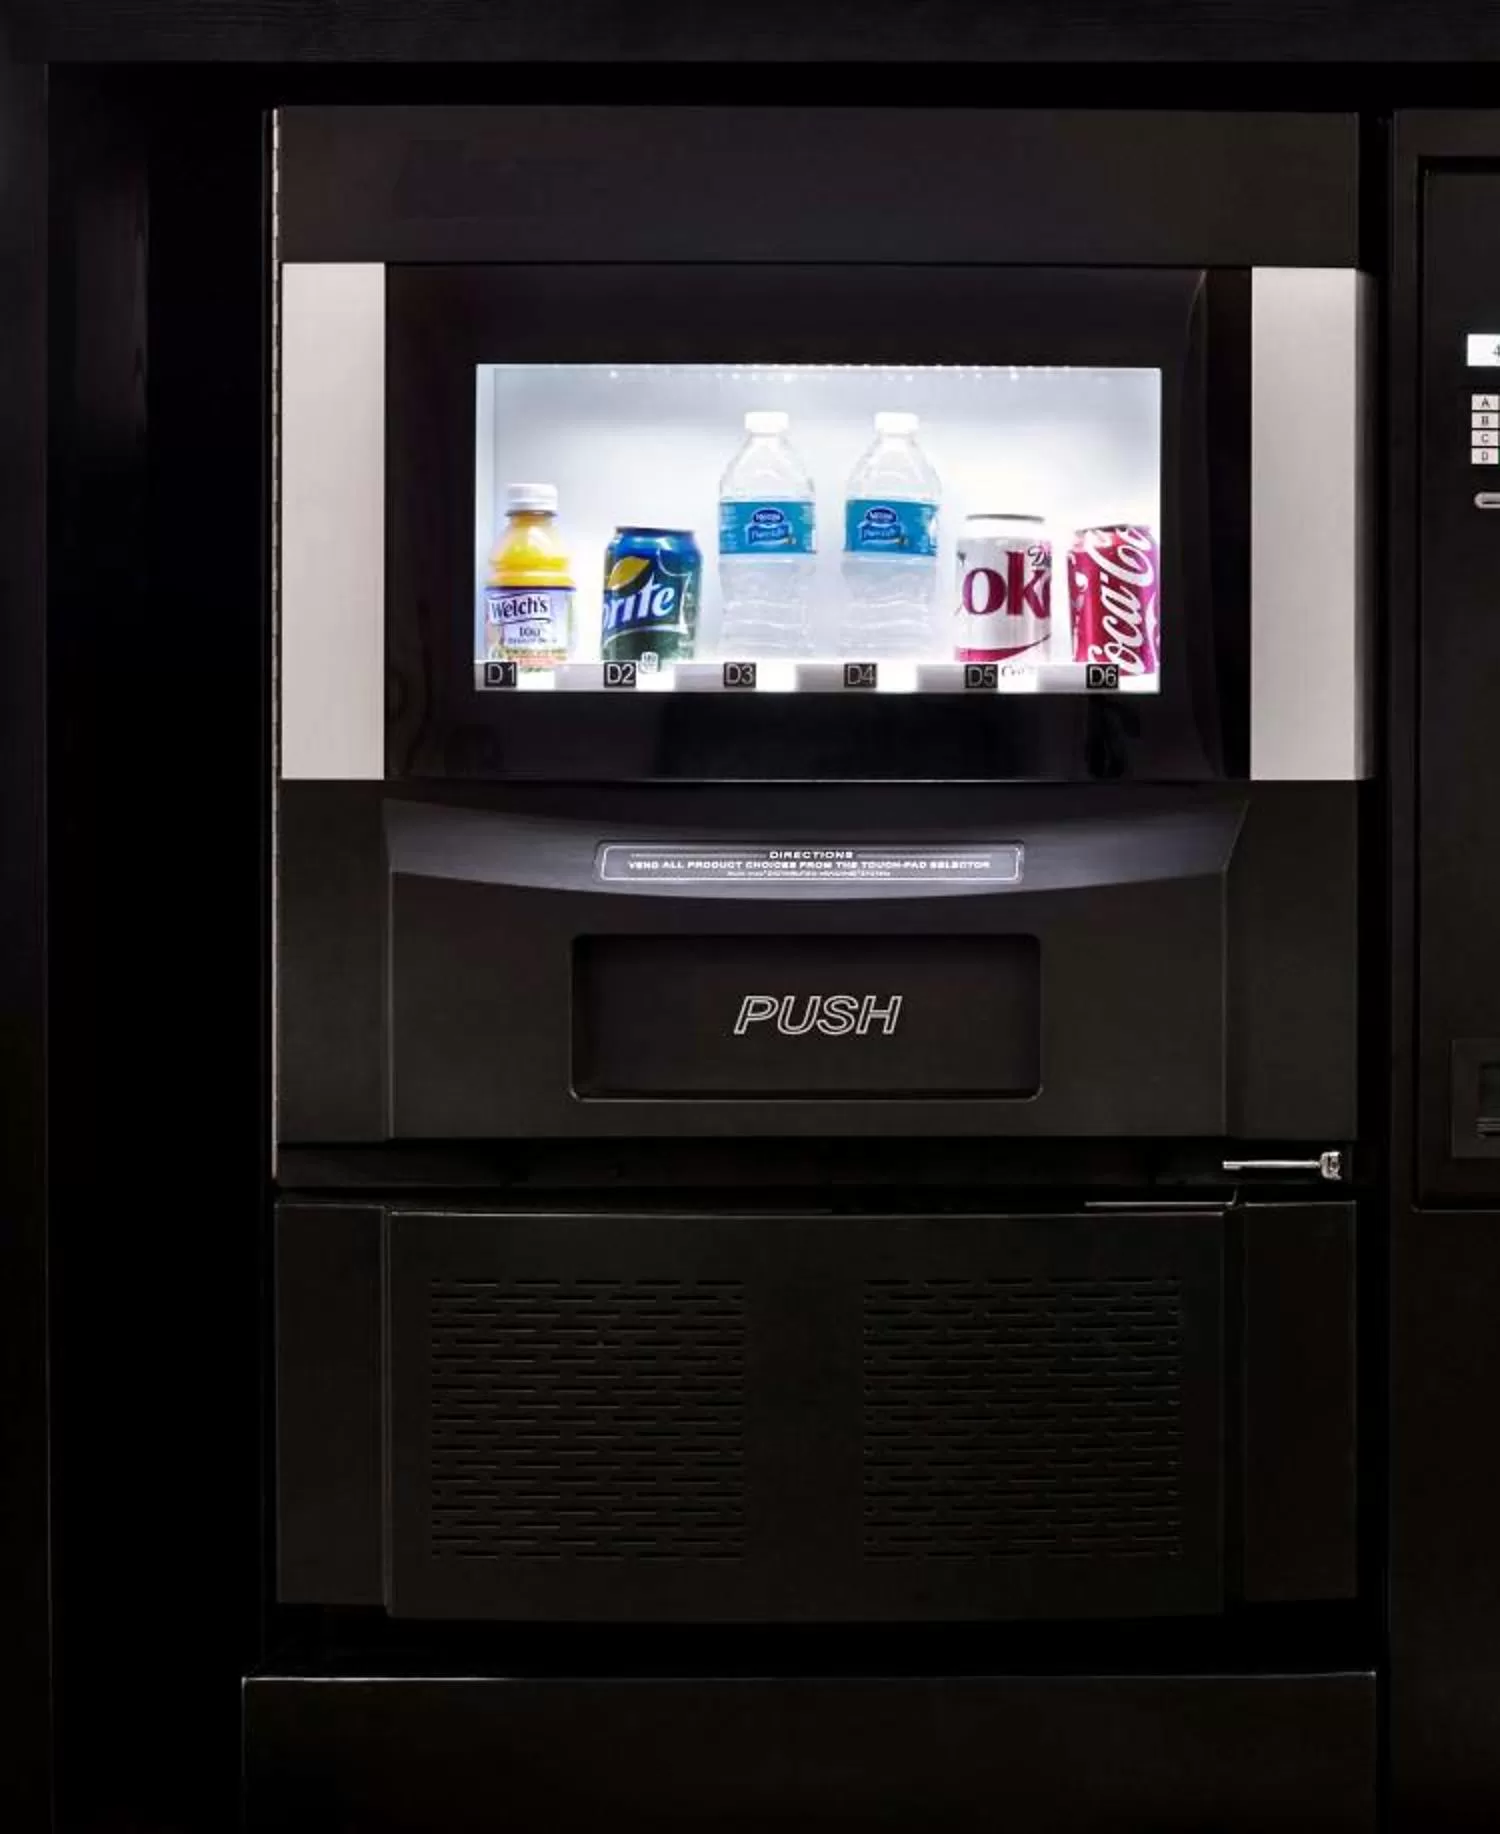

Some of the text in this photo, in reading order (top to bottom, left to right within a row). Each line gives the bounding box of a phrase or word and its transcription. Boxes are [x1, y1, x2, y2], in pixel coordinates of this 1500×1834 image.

[1481, 398, 1490, 408] A
[1481, 416, 1489, 425] B
[1481, 434, 1489, 443] C
[1481, 452, 1489, 461] D
[962, 550, 1052, 619] ok
[491, 596, 548, 619] Welch's
[487, 663, 515, 685] D1
[607, 664, 635, 685] D2
[725, 664, 754, 685] D3
[846, 666, 874, 685] D4
[967, 666, 996, 686] D5
[1089, 666, 1117, 686] D6
[628, 860, 659, 869] VEND
[662, 860, 684, 869] ALL
[687, 860, 742, 869] PRODUCT
[746, 860, 797, 869] CHOICES
[799, 860, 833, 869] FROM
[836, 860, 858, 869] THE
[930, 860, 991, 869] SELECTOR
[769, 851, 854, 859] DIRECTIONS
[734, 995, 903, 1035] PUSH
